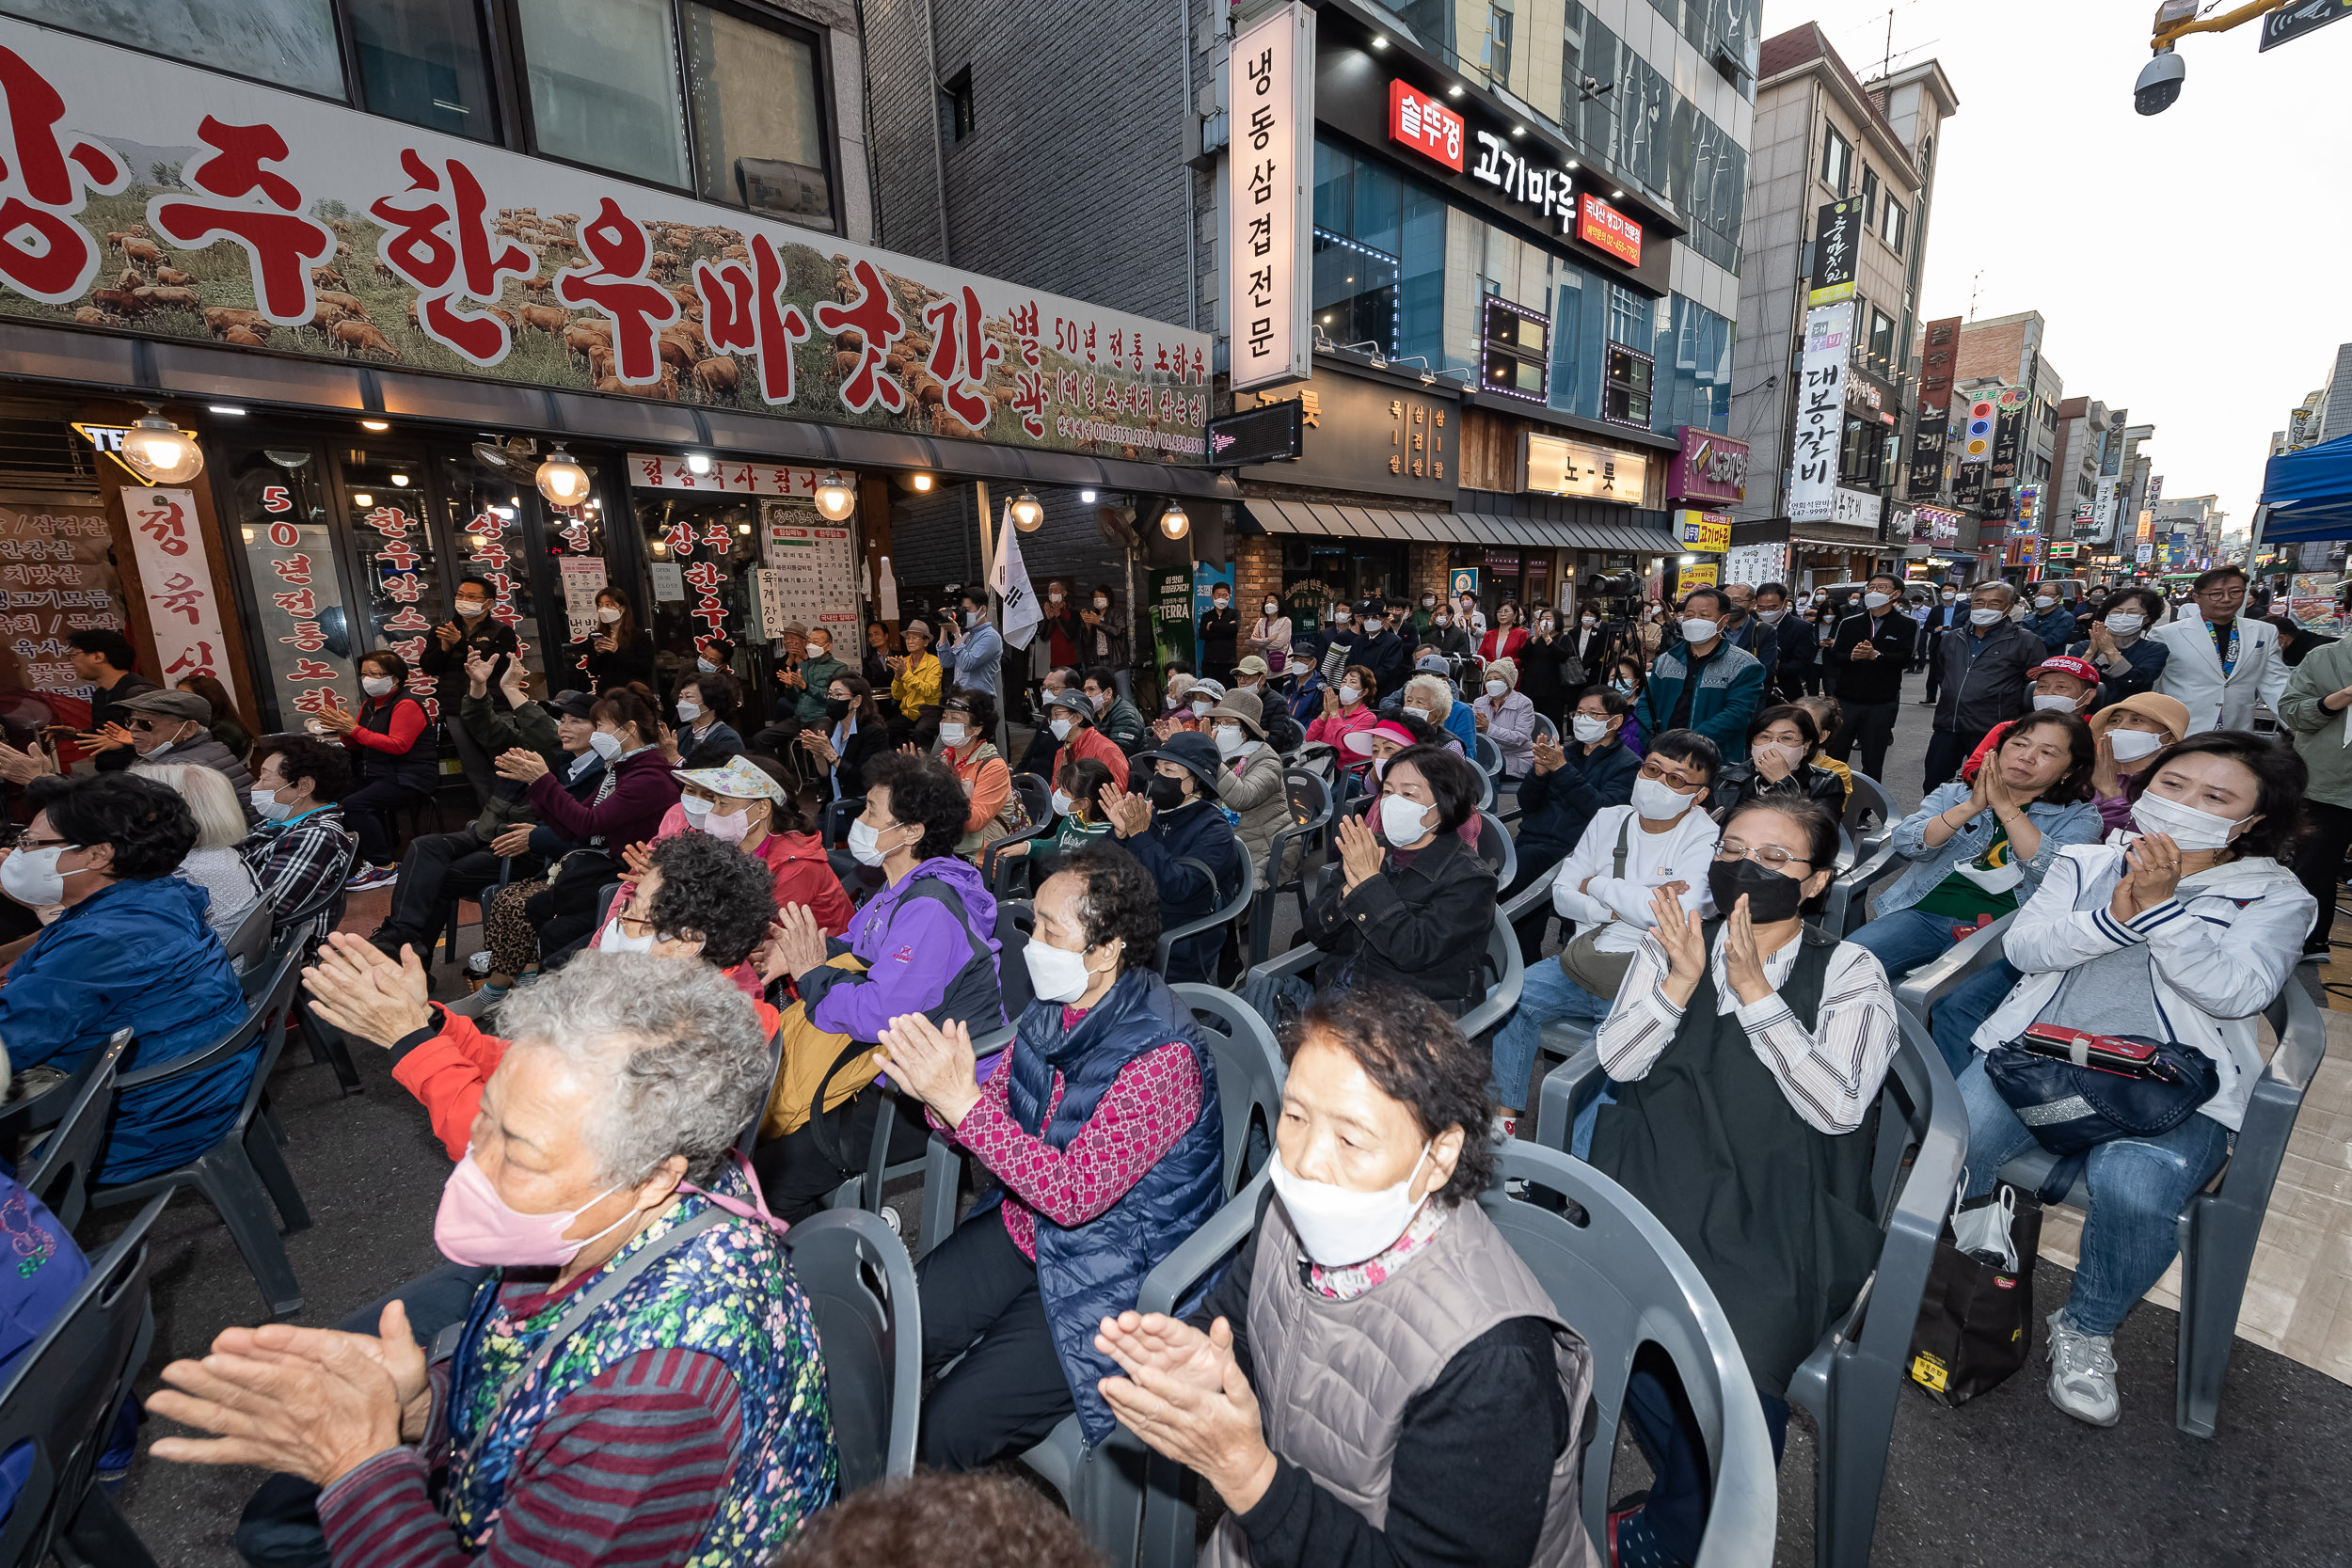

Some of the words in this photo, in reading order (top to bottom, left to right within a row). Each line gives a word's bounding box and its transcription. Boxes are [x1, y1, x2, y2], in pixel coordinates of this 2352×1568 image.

[1401, 94, 1460, 160] 솥뚜껑
[1473, 130, 1577, 234] 고기마루
[1586, 199, 1606, 225] 국내산
[1607, 212, 1624, 235] 생고기
[1625, 221, 1641, 245] 전문점
[1586, 224, 1607, 244] 예약문의
[1607, 233, 1638, 261] 02-455-7752
[1009, 300, 1049, 438] 별관
[1056, 317, 1097, 363] 50년
[1108, 328, 1144, 372] 전통
[1154, 342, 1205, 387] 노하우
[1057, 367, 1096, 409] (매일
[1103, 380, 1153, 418] 소,돼지
[1160, 389, 1207, 428] 잡는날)
[1973, 390, 1996, 402] 프로
[1412, 405, 1424, 477] 삼겹살
[1798, 364, 1838, 484] 대봉갈비
[642, 456, 759, 492] 점심식사
[1708, 448, 1747, 489] 노래방
[32, 515, 108, 537] 삼겹살
[1791, 506, 1828, 517] 447-9999
[0, 540, 75, 560] 안창살
[663, 521, 733, 555] 상주
[1700, 526, 1728, 549] 고기마루
[4, 564, 83, 585] 치맛살
[763, 571, 778, 625] 육계장
[1159, 604, 1190, 621] TERRA
